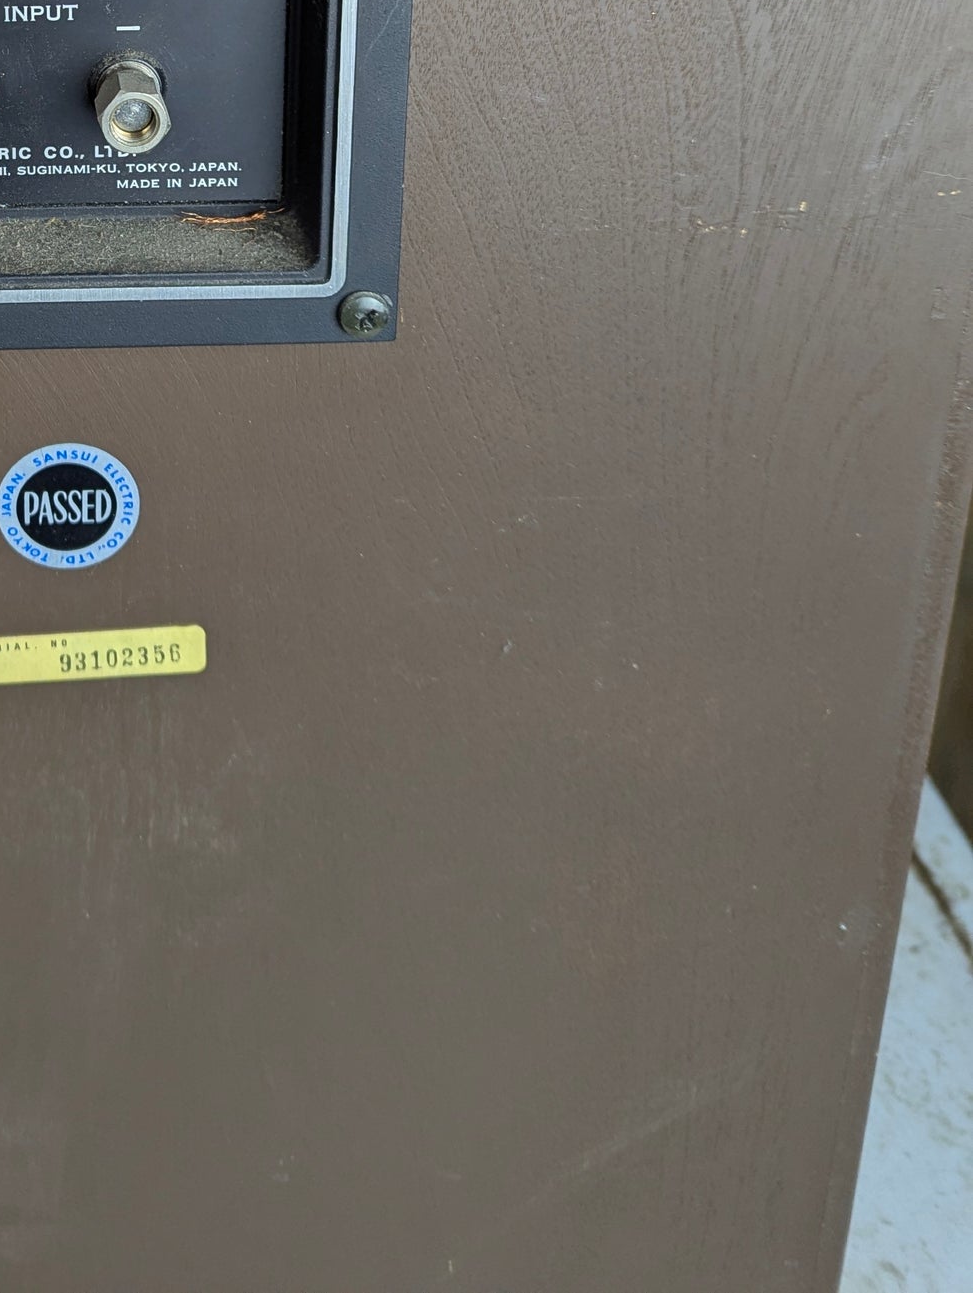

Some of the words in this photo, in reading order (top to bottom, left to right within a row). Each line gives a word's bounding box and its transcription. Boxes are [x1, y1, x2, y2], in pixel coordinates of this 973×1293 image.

[4, 4, 79, 22] INPUT
[43, 146, 85, 160] CO.,
[189, 162, 242, 172] JAPAN.
[116, 179, 160, 189] MADE
[167, 178, 182, 188] IN
[189, 177, 238, 188] JAPAN
[32, 449, 99, 467] SANSUI
[103, 463, 134, 526] ELECTRIC
[23, 489, 112, 526] PASSED
[7, 526, 49, 563] TOKYO
[50, 638, 68, 648] NO
[59, 643, 182, 673] 93102356
